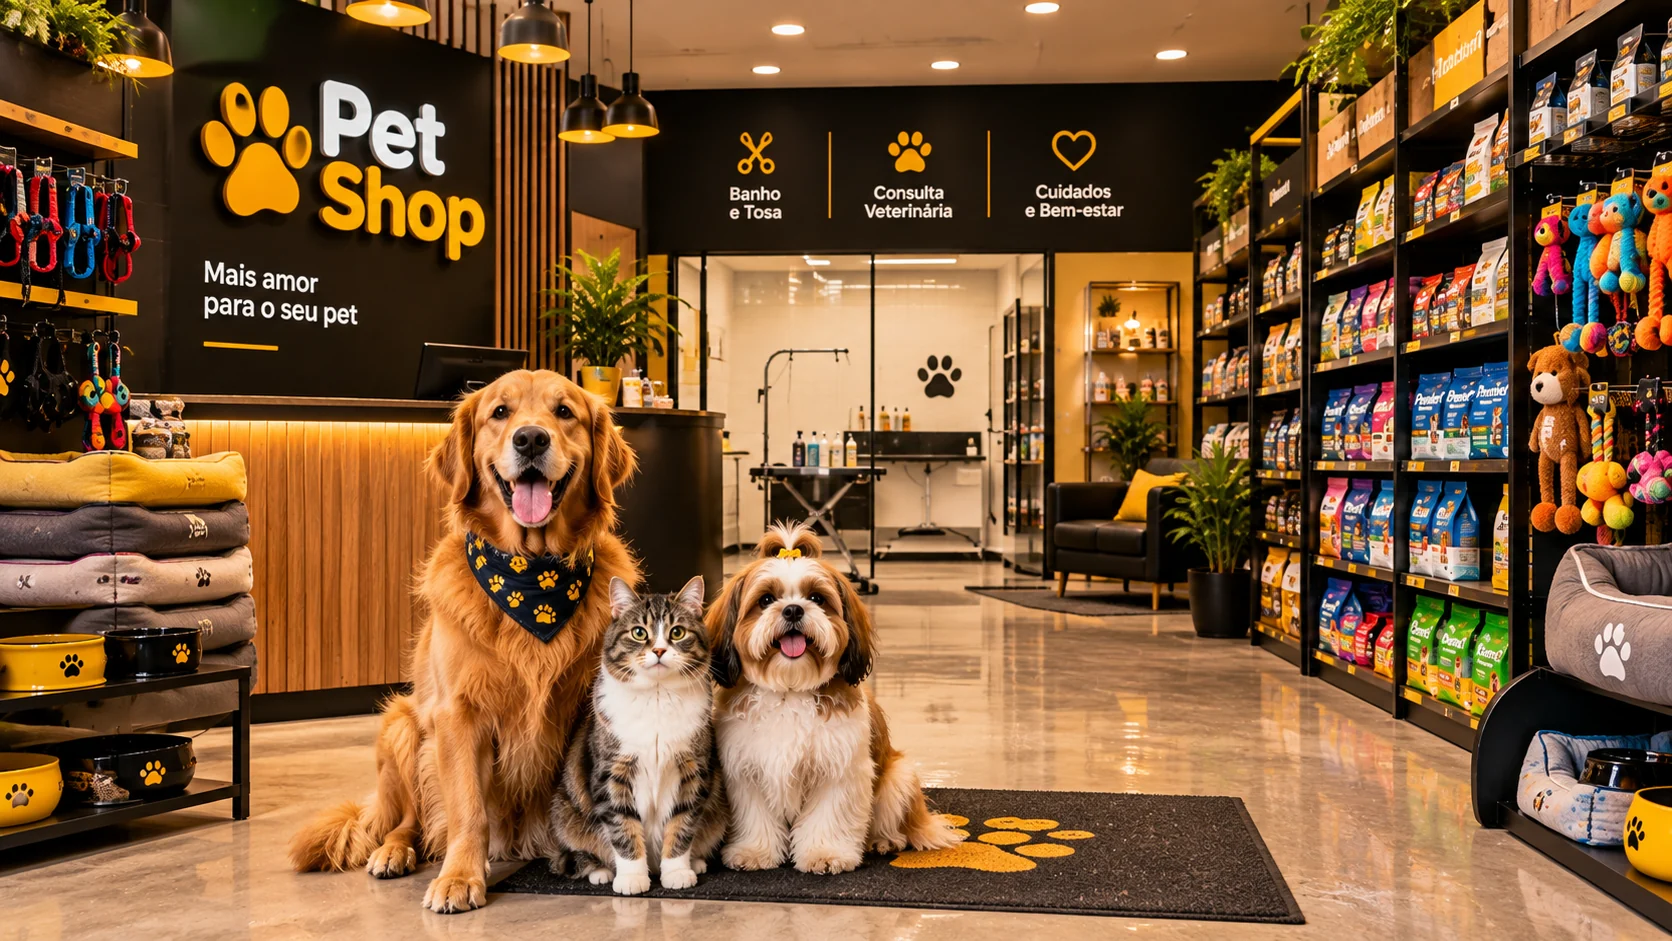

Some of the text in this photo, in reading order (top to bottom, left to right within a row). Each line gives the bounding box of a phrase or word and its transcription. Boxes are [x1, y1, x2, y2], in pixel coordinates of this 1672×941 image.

[319, 79, 446, 177] Pet
[729, 186, 781, 202] Banho
[873, 185, 944, 200] Consulta
[1035, 184, 1112, 199] Cuidados
[318, 160, 486, 262] Shop
[729, 204, 782, 220] e Tosa
[864, 203, 953, 219] Veterinária
[1024, 202, 1125, 218] e Bem-estar
[203, 260, 319, 294] Mais amor
[203, 295, 359, 328] para o seu pet
